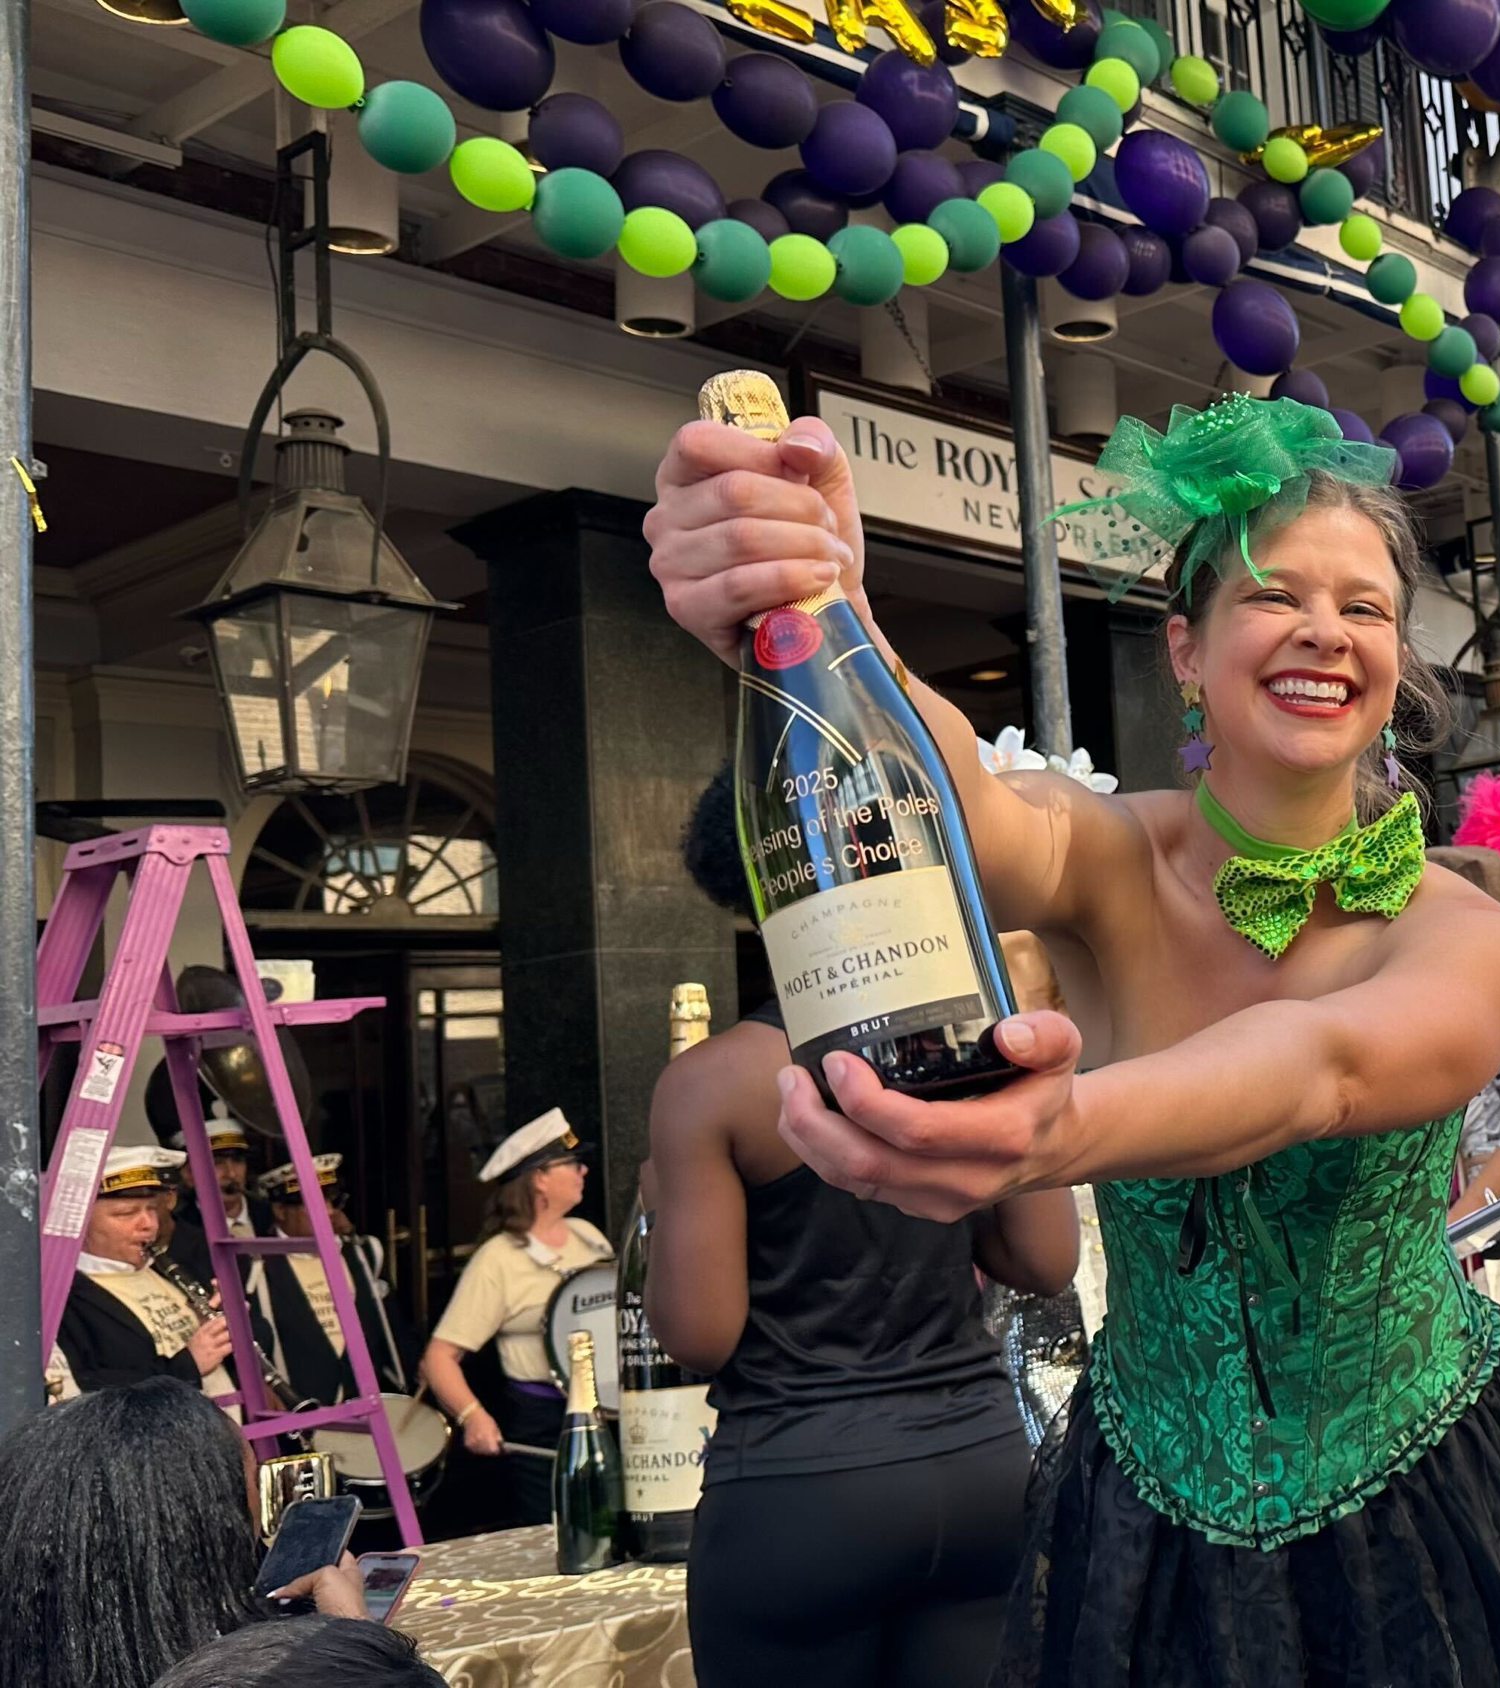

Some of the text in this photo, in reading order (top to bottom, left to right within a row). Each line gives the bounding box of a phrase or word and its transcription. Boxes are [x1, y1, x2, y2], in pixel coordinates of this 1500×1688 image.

[842, 411, 918, 470] The
[782, 767, 839, 803] 2025
[748, 793, 939, 863] easing of the Poles
[841, 836, 923, 869] Choice
[791, 898, 903, 940] CHAMPAGNE
[784, 967, 822, 1000] MOËT
[827, 966, 839, 981] &
[841, 934, 950, 975] CHANDON
[819, 967, 904, 1000] IMPÉRIAL
[850, 1015, 891, 1038] BRUT
[633, 1449, 701, 1469] CHANDO
